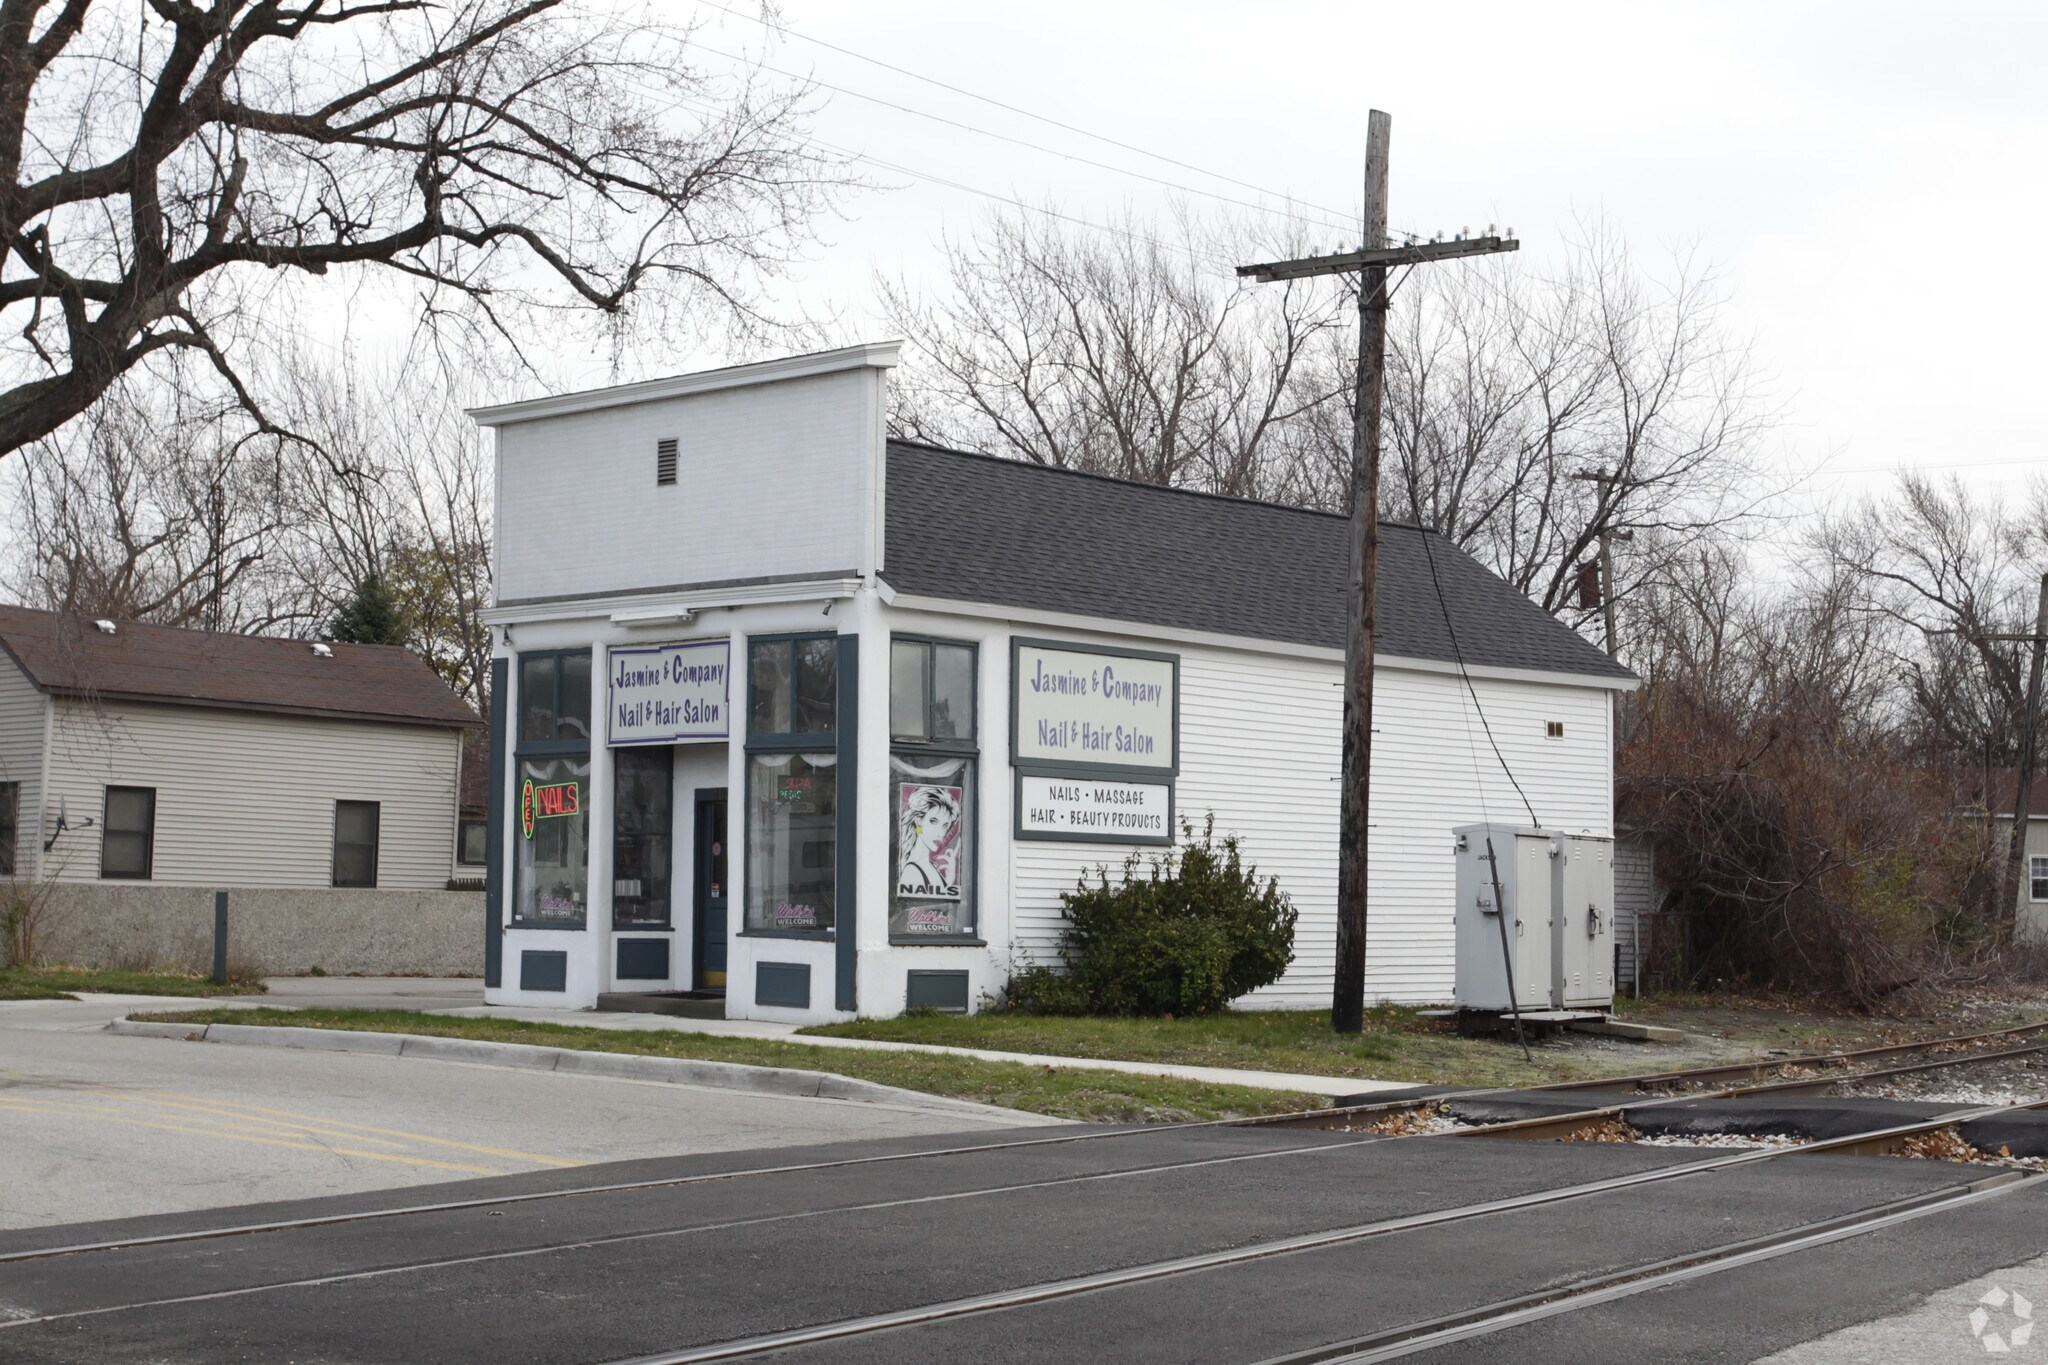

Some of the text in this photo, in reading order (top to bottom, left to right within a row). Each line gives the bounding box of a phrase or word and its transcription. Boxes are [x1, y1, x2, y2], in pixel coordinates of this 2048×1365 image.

[616, 655, 724, 688] Jasmine & Company
[1030, 659, 1162, 707] Jasmine & Company
[619, 698, 719, 727] Nail & Hair Salon
[1038, 719, 1153, 754] Nail & Hair Salon
[538, 785, 577, 815] NAILS
[1049, 786, 1144, 805] NAILS MASSAGE
[1030, 808, 1161, 829] HAIR BEAUTY PRODUCTS
[900, 884, 959, 896] NAILS
[909, 924, 950, 932] WELCOME
